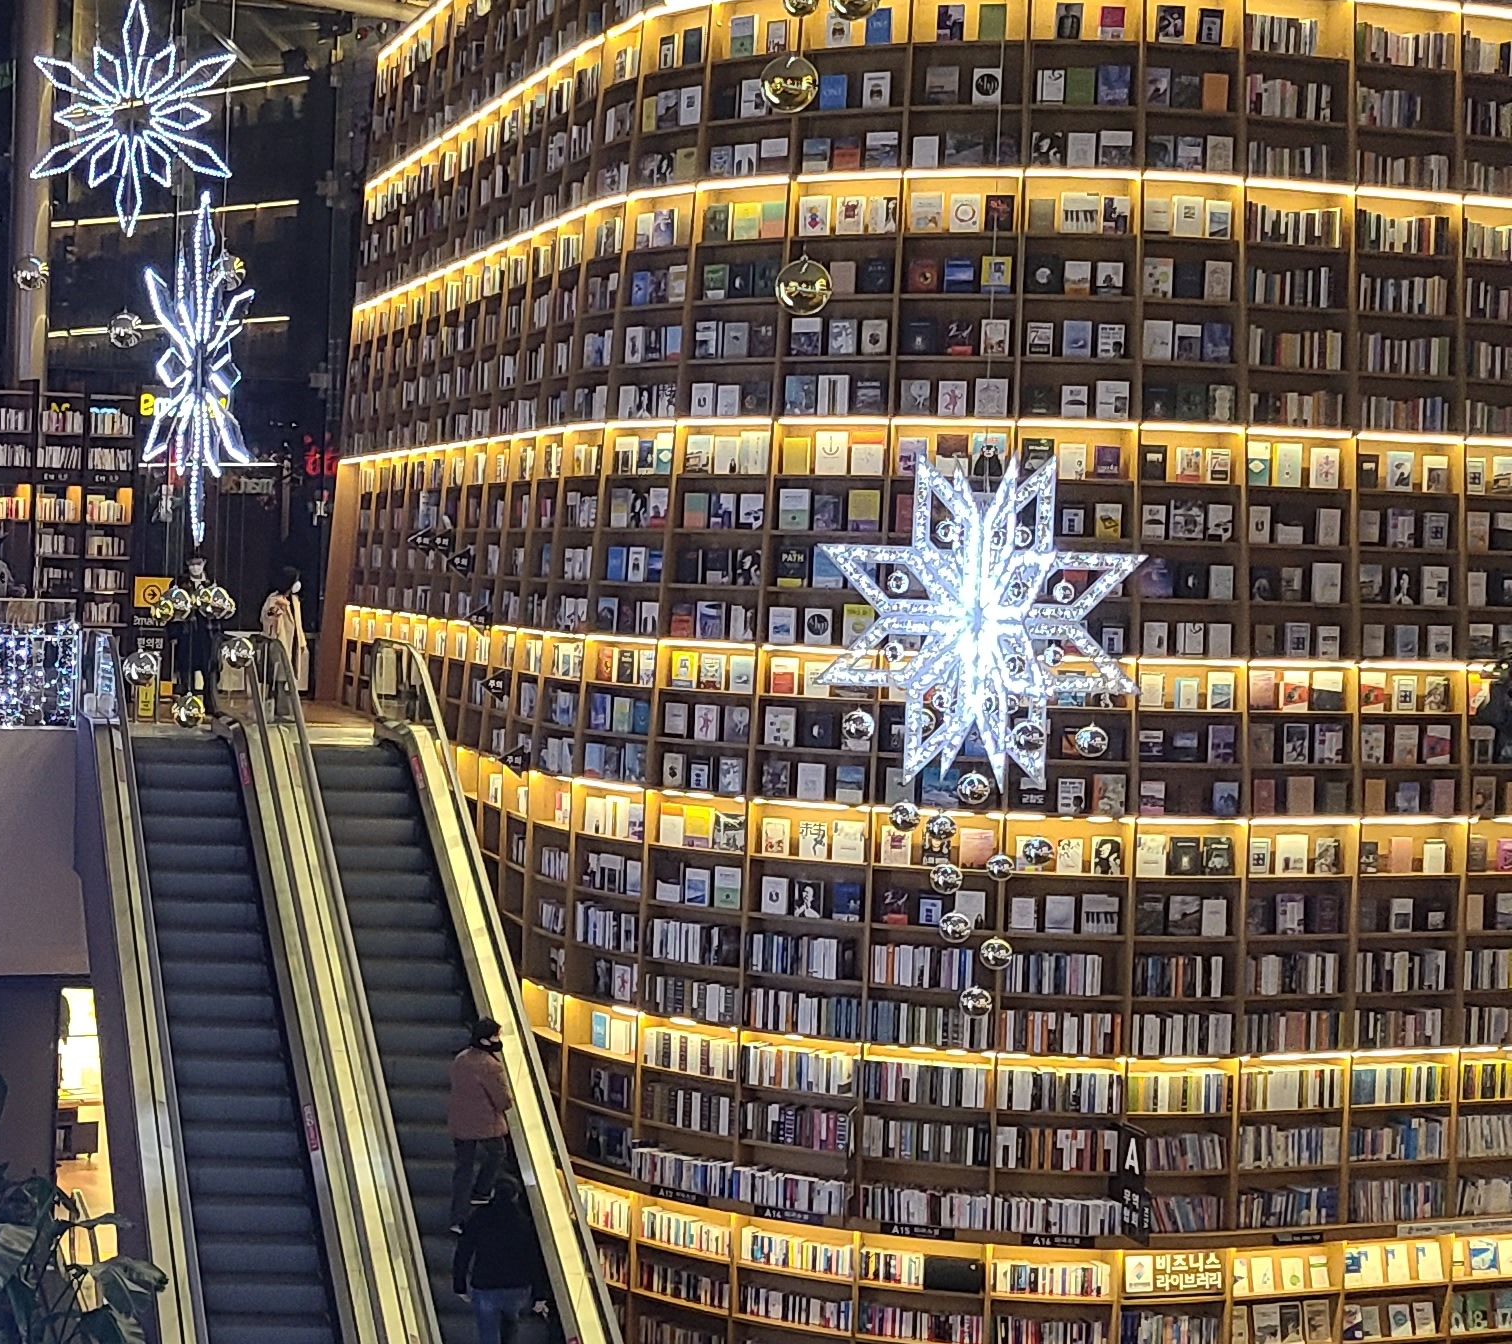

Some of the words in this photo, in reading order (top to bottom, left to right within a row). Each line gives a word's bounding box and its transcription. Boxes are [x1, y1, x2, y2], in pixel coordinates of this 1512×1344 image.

[781, 553, 804, 563] PATH
[1125, 1137, 1139, 1175] A
[891, 1225, 910, 1236] A15
[1032, 1236, 1052, 1246] A16
[1155, 1252, 1222, 1273] 비즈니스
[1155, 1271, 1222, 1292] 라이브러리
